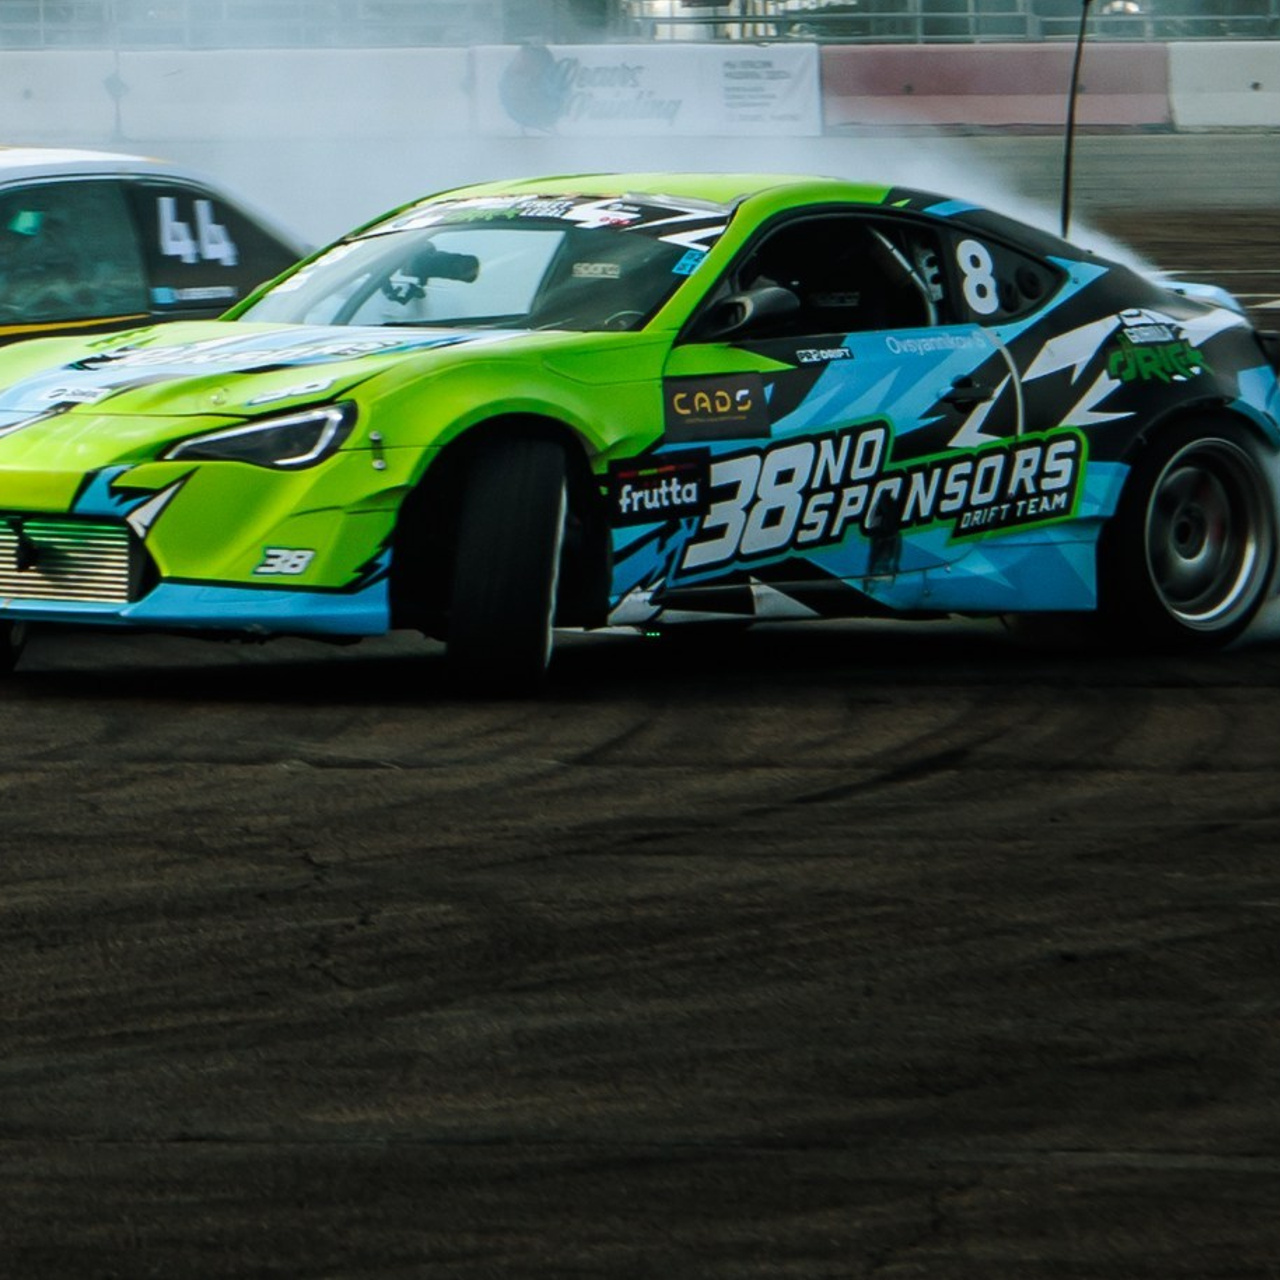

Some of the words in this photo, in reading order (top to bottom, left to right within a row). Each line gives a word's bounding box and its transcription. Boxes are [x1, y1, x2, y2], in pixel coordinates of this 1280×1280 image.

[157, 197, 238, 267] 44
[957, 239, 1000, 316] 8
[673, 389, 752, 415] CADS
[619, 477, 699, 513] frutta
[681, 441, 815, 570] 38
[811, 428, 885, 489] NO
[797, 439, 1077, 543] SPONSORS
[960, 503, 1011, 529] DRIFT
[1015, 492, 1068, 517] TEAM
[255, 548, 316, 574] 38
